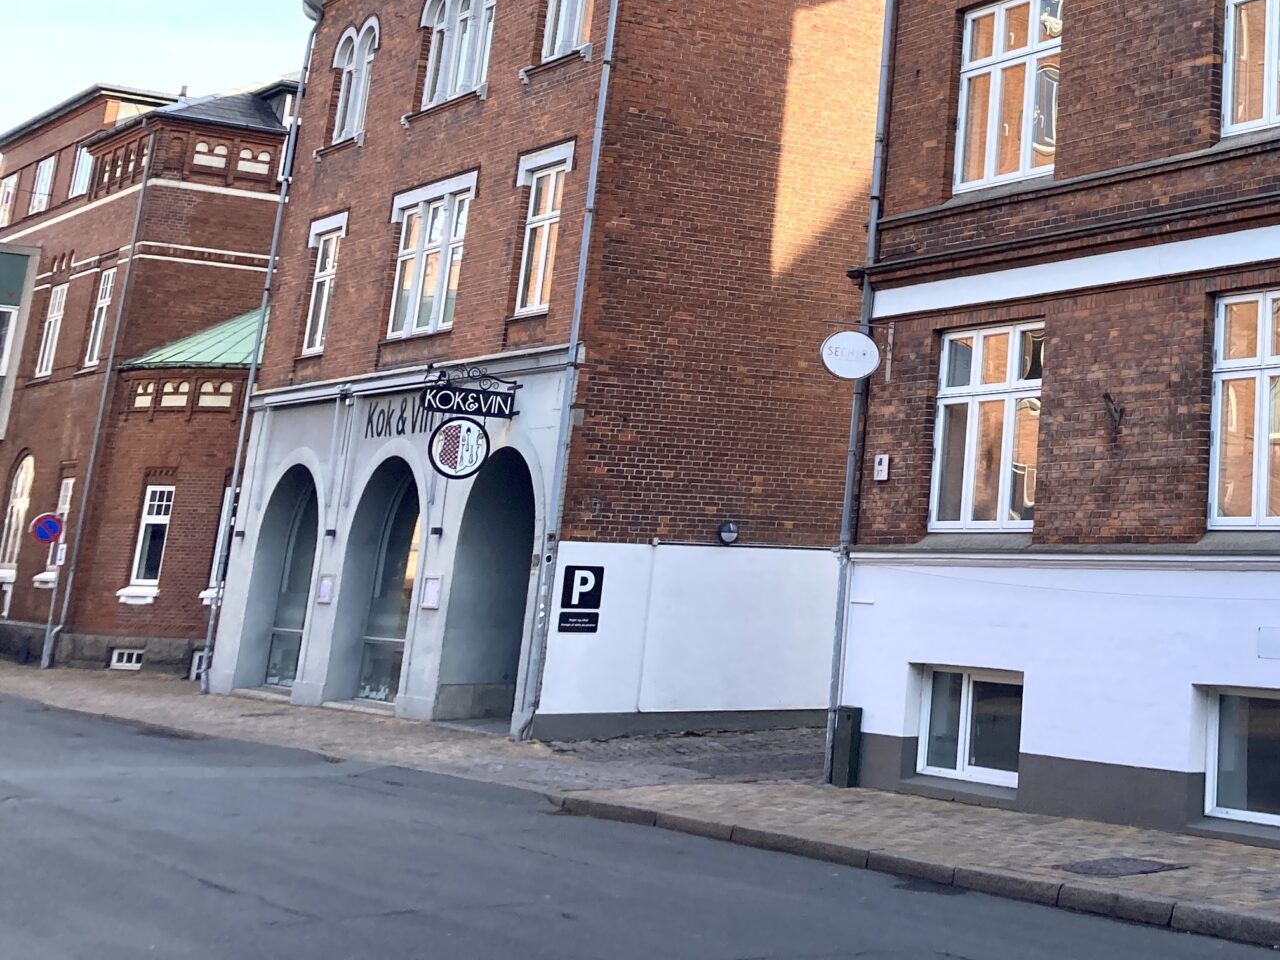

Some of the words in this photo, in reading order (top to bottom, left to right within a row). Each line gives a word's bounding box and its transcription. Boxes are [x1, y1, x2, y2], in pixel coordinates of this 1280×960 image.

[365, 399, 395, 439] Kok
[396, 397, 407, 435] &
[424, 389, 512, 415] KOK&VIN
[571, 570, 596, 605] P
